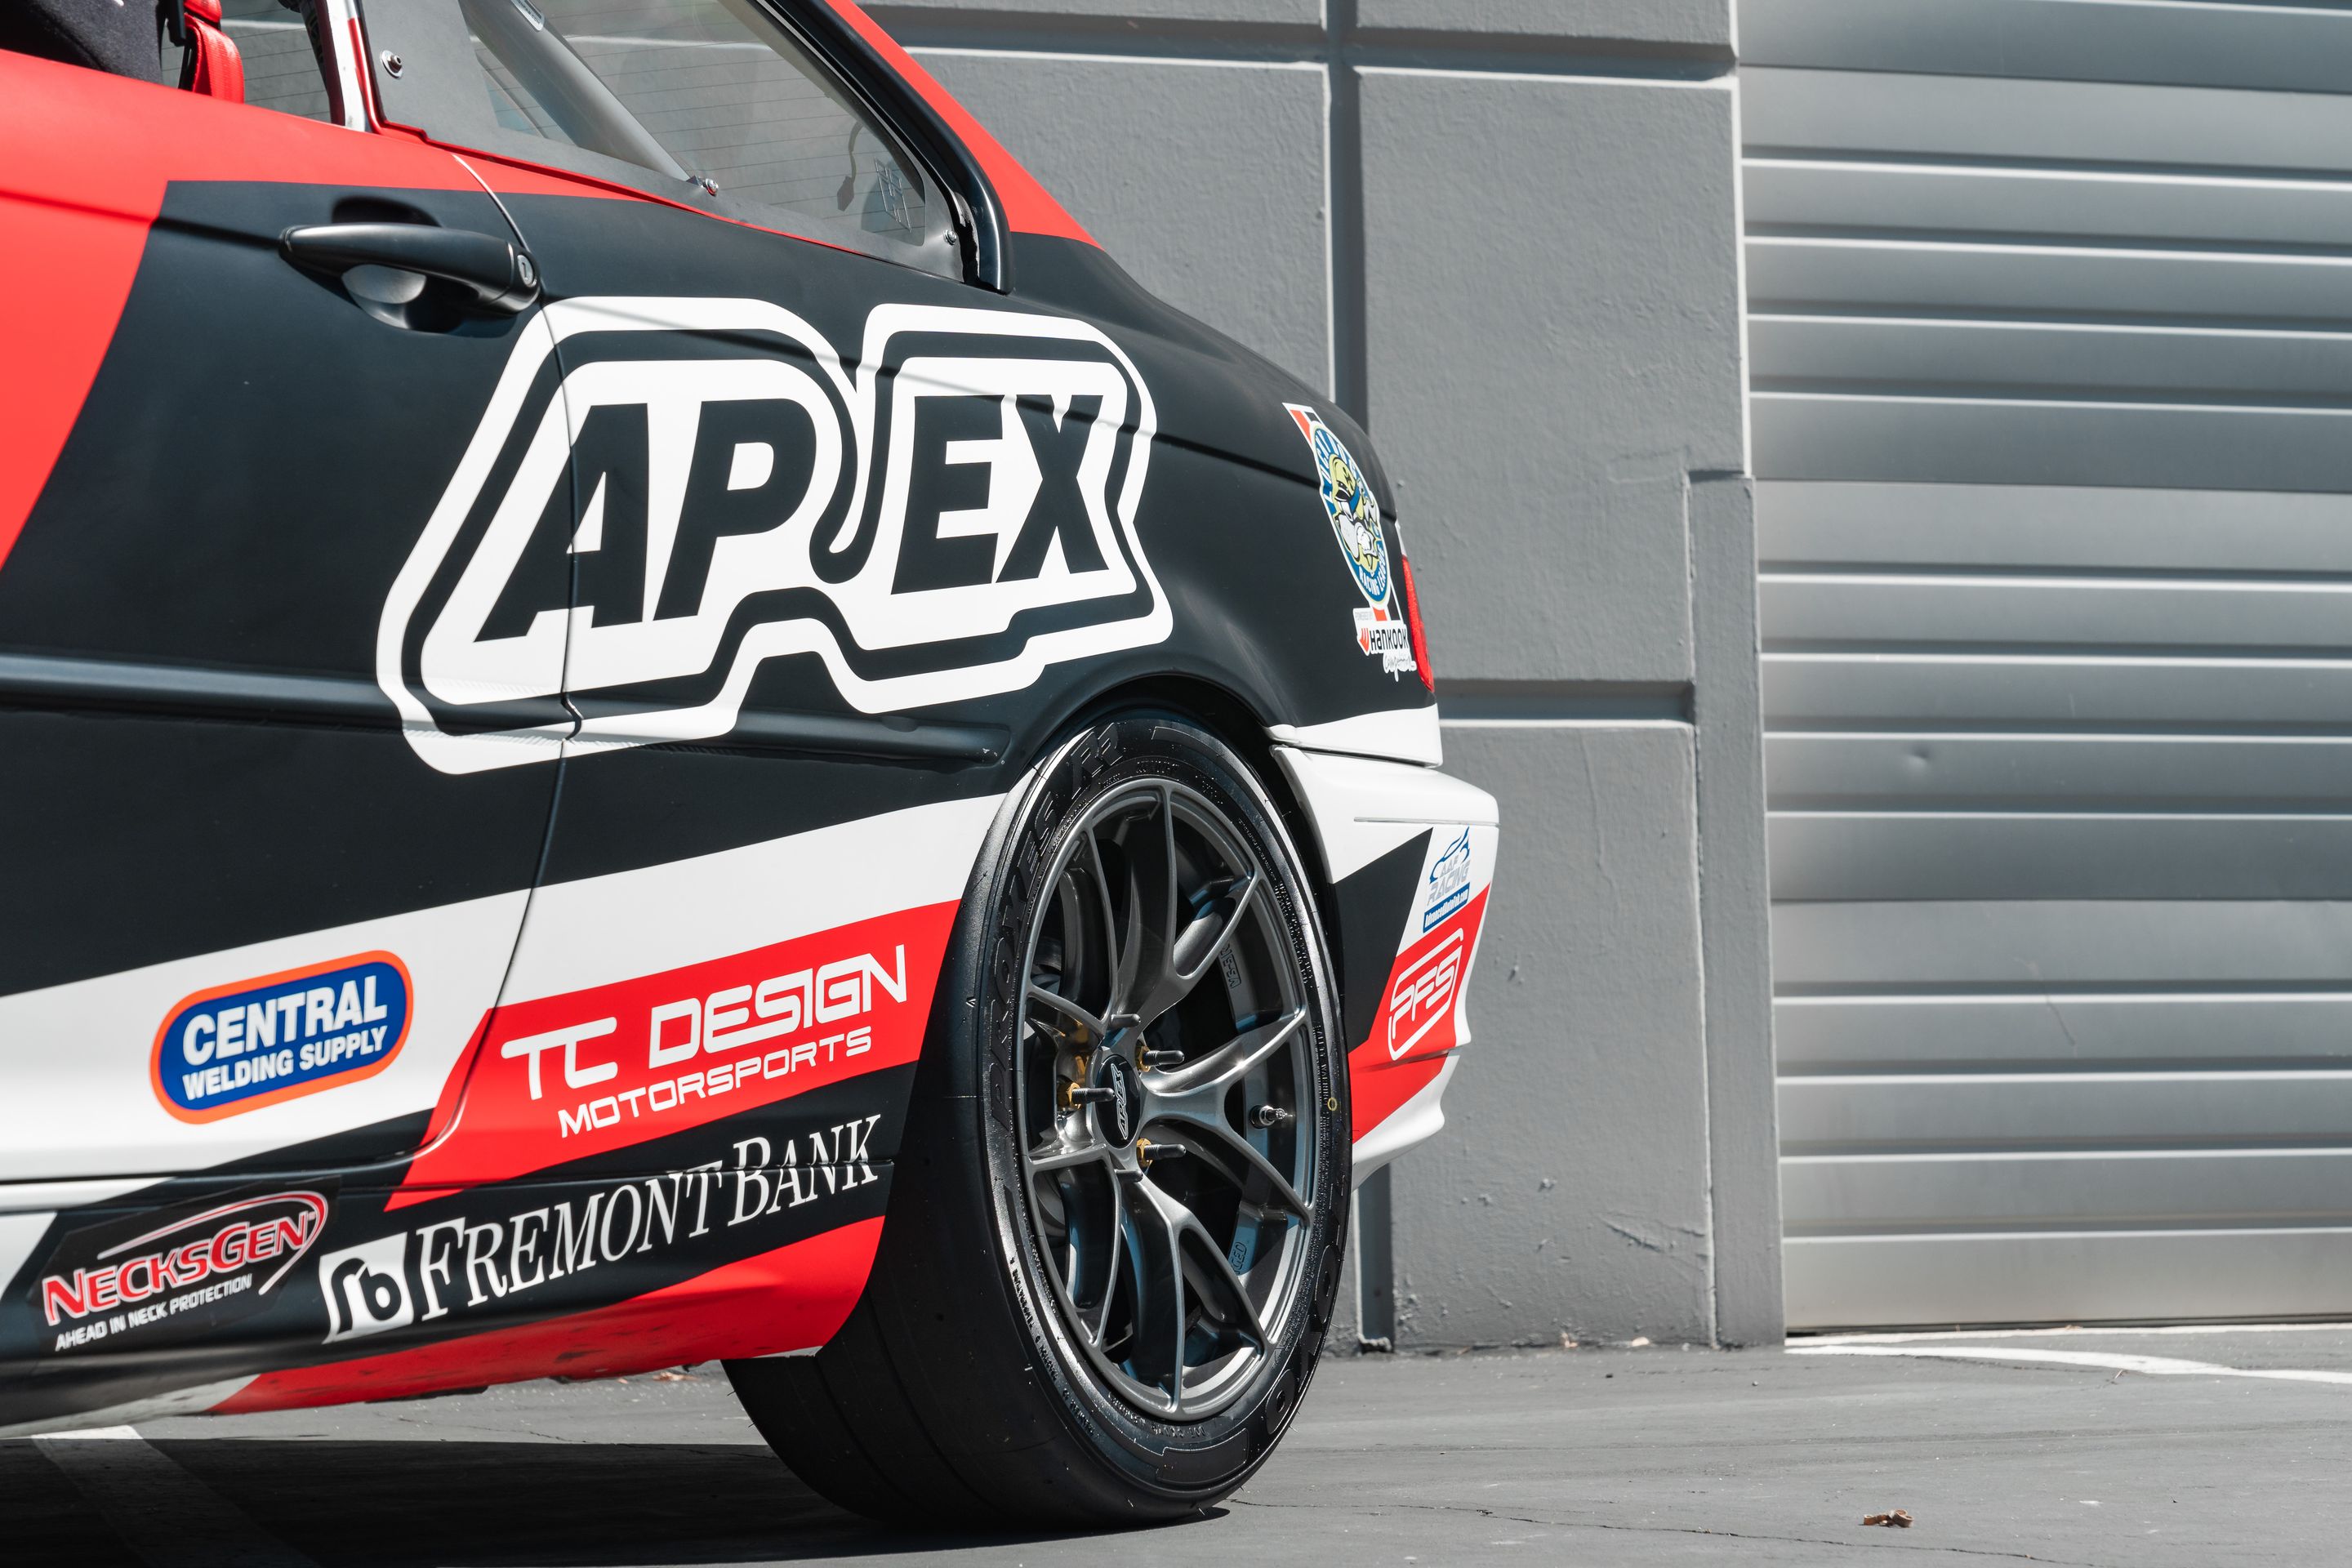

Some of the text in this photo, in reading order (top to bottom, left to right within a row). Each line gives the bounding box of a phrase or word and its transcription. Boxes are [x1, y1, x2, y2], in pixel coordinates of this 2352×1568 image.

[474, 394, 1110, 644] APEX
[1359, 547, 1387, 597] RACING LEAGUE
[1427, 859, 1471, 906] RACING
[182, 975, 388, 1066] CENTRAL
[501, 944, 907, 1101] TC DESIGN
[1390, 945, 1463, 1040] PFS
[182, 1025, 388, 1101] WELDING SUPPLY
[558, 1026, 872, 1138] MOTORSPORTS
[1111, 1065, 1128, 1138] APEX
[416, 1114, 881, 1321] FREMONT BANK
[55, 1273, 252, 1352] AHEAD IN NECK PROTECTION
